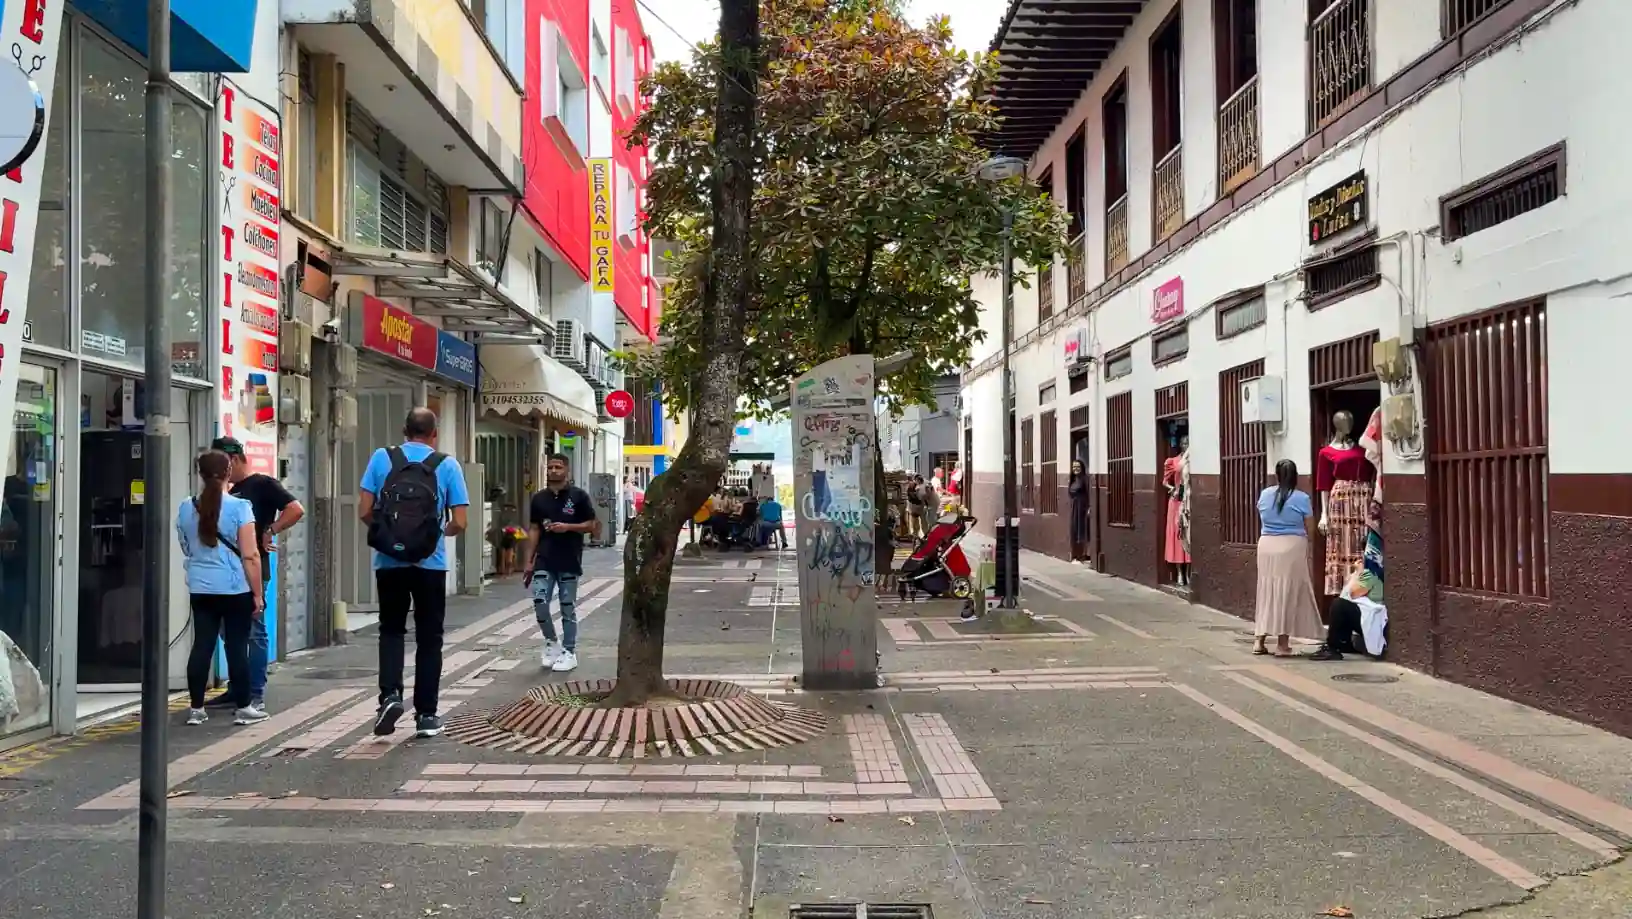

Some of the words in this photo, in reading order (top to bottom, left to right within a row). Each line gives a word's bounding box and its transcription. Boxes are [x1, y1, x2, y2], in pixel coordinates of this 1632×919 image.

[254, 155, 276, 185] Cocina
[250, 188, 277, 219] Muebles
[592, 163, 608, 225] REPARA
[243, 222, 277, 255] Colchones
[594, 230, 610, 240] TU
[596, 246, 610, 287] GAFA
[380, 307, 414, 345] Apostar
[490, 395, 545, 405] 3104532355
